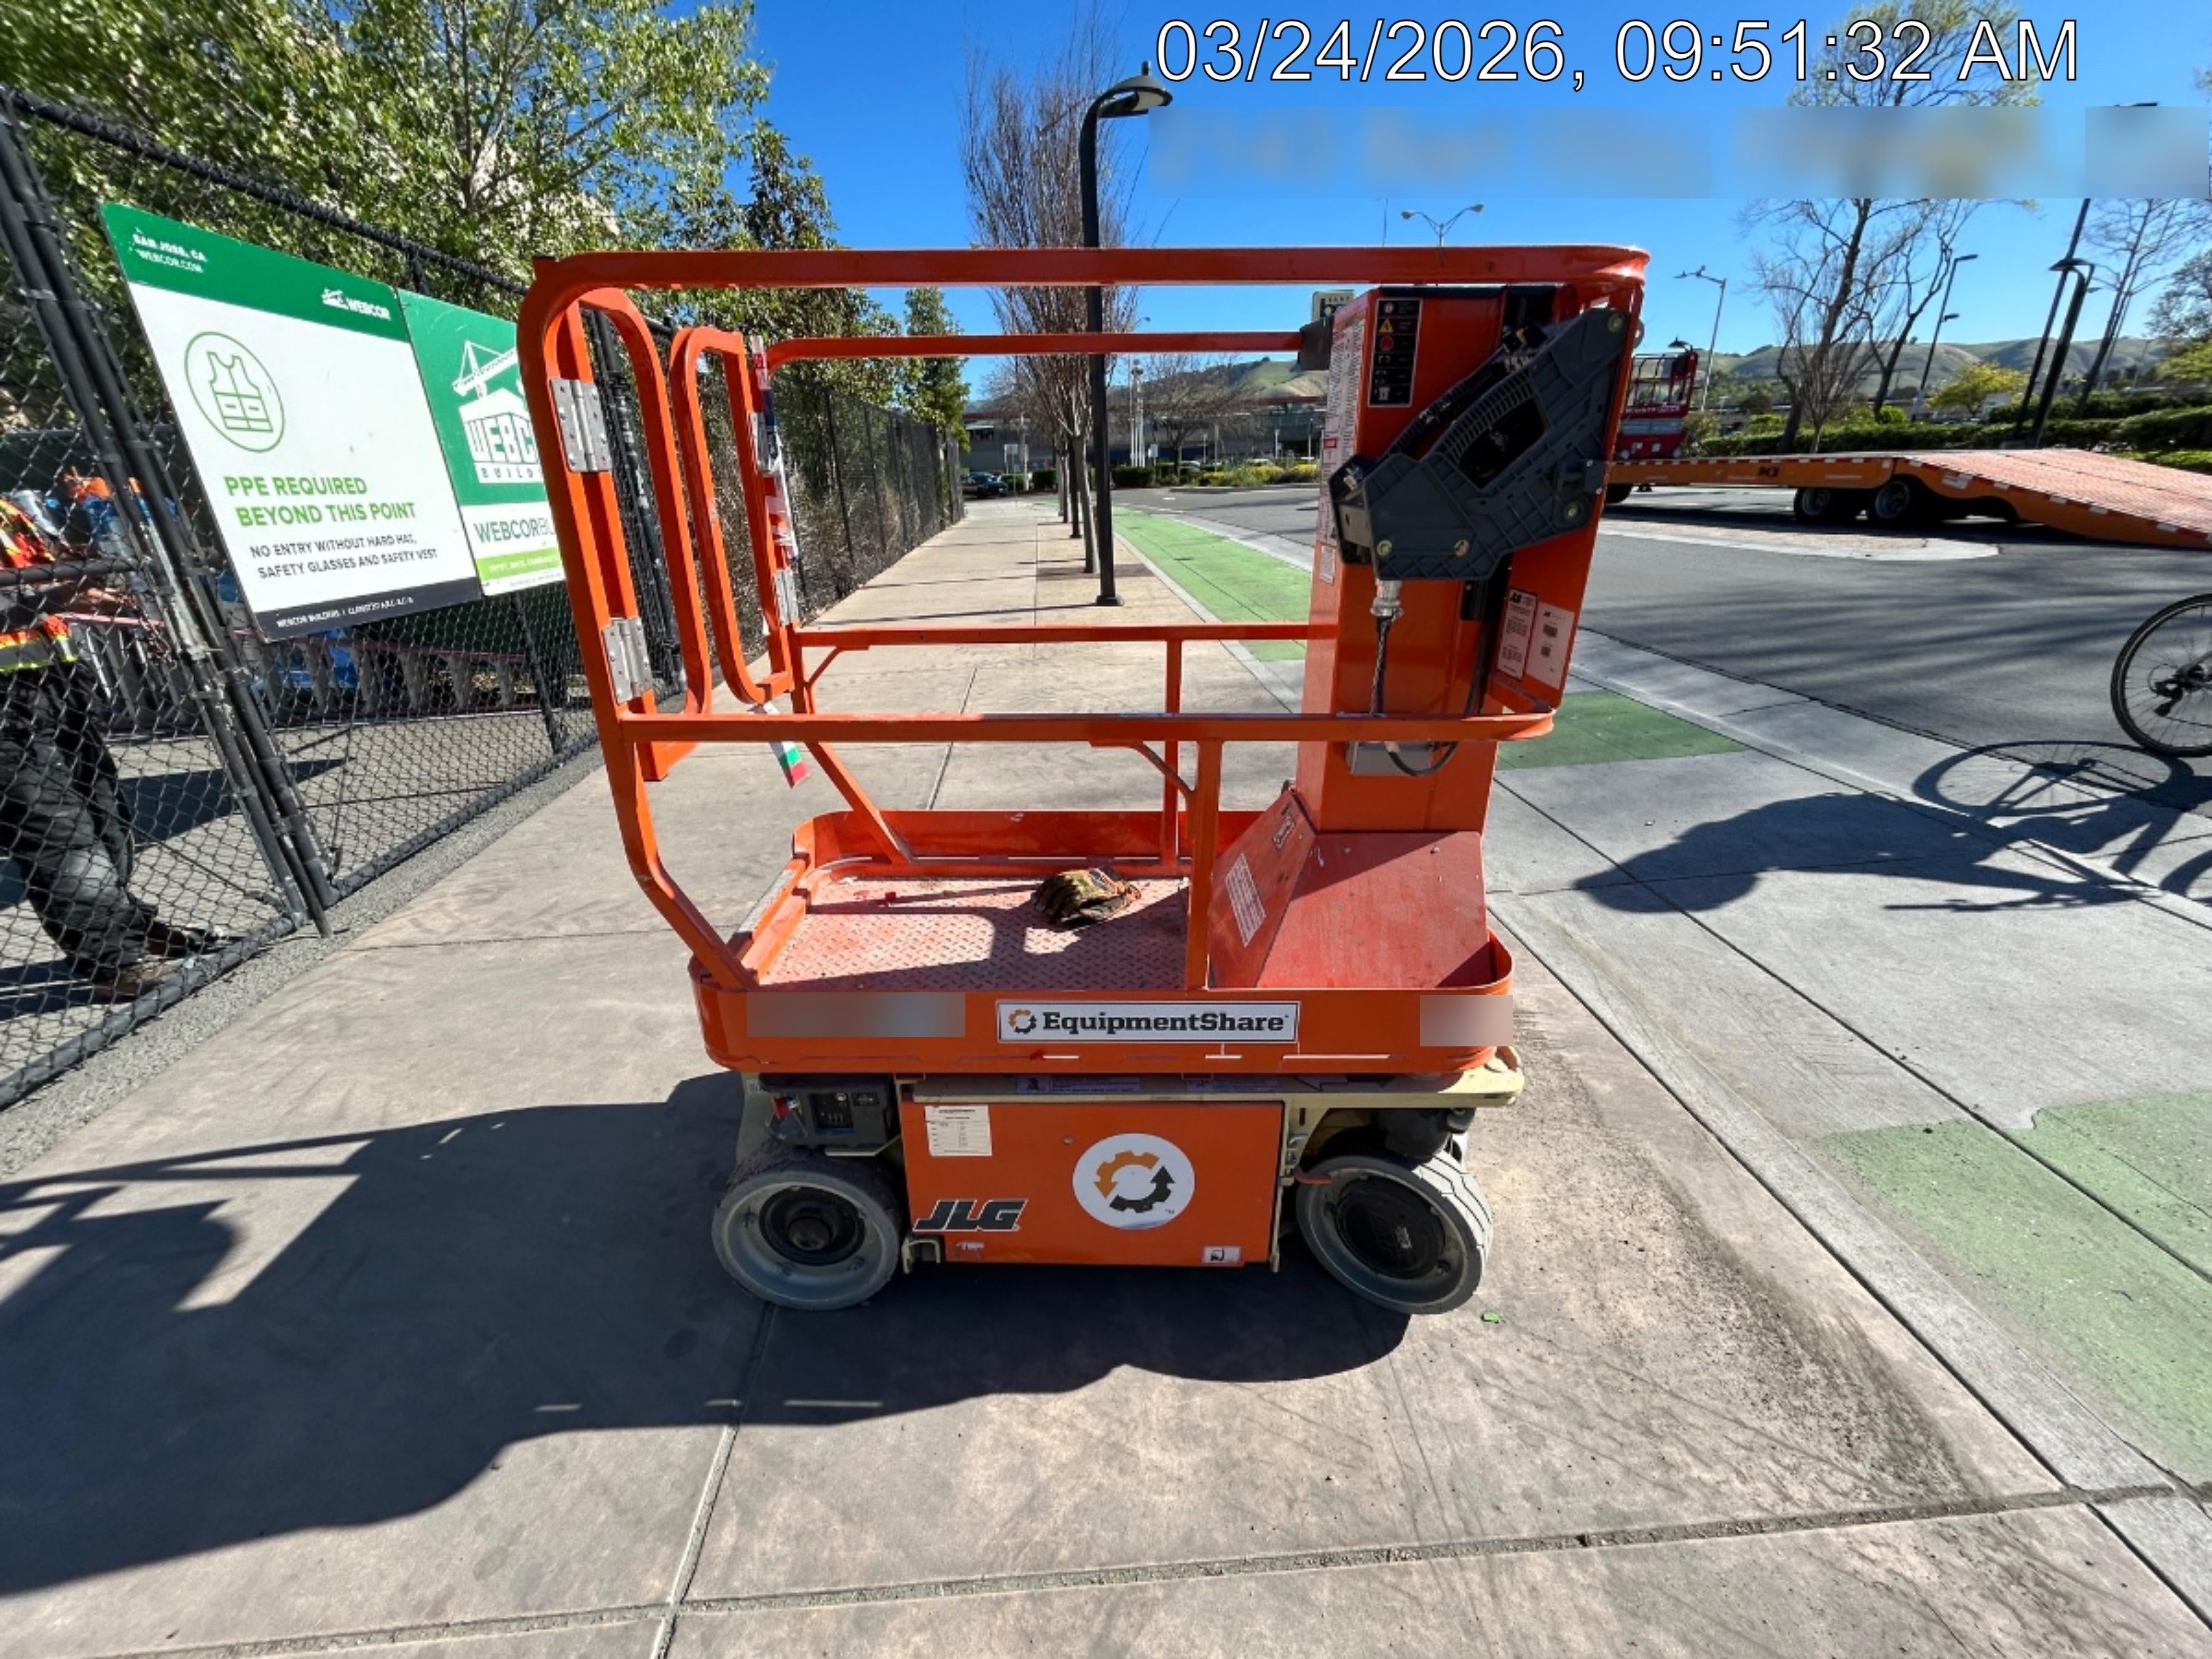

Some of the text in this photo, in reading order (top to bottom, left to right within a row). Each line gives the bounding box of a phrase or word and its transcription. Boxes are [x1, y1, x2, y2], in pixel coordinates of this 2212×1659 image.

[345, 297, 391, 321] WEBCOR
[463, 413, 539, 465] WEBC
[481, 467, 542, 478] BUILD
[223, 476, 368, 496] PPE REQUIRED
[235, 502, 416, 527] BEYOND THIS POINT
[249, 545, 270, 559] NO
[272, 541, 313, 556] ENTRY
[315, 538, 366, 552] WITHOUT
[367, 534, 394, 547] HARD
[258, 548, 438, 579] SAFETY GLASSES AND SAFETY VEST
[1043, 1011, 1284, 1035] EquipmentShare
[913, 1198, 1029, 1231] JLG
